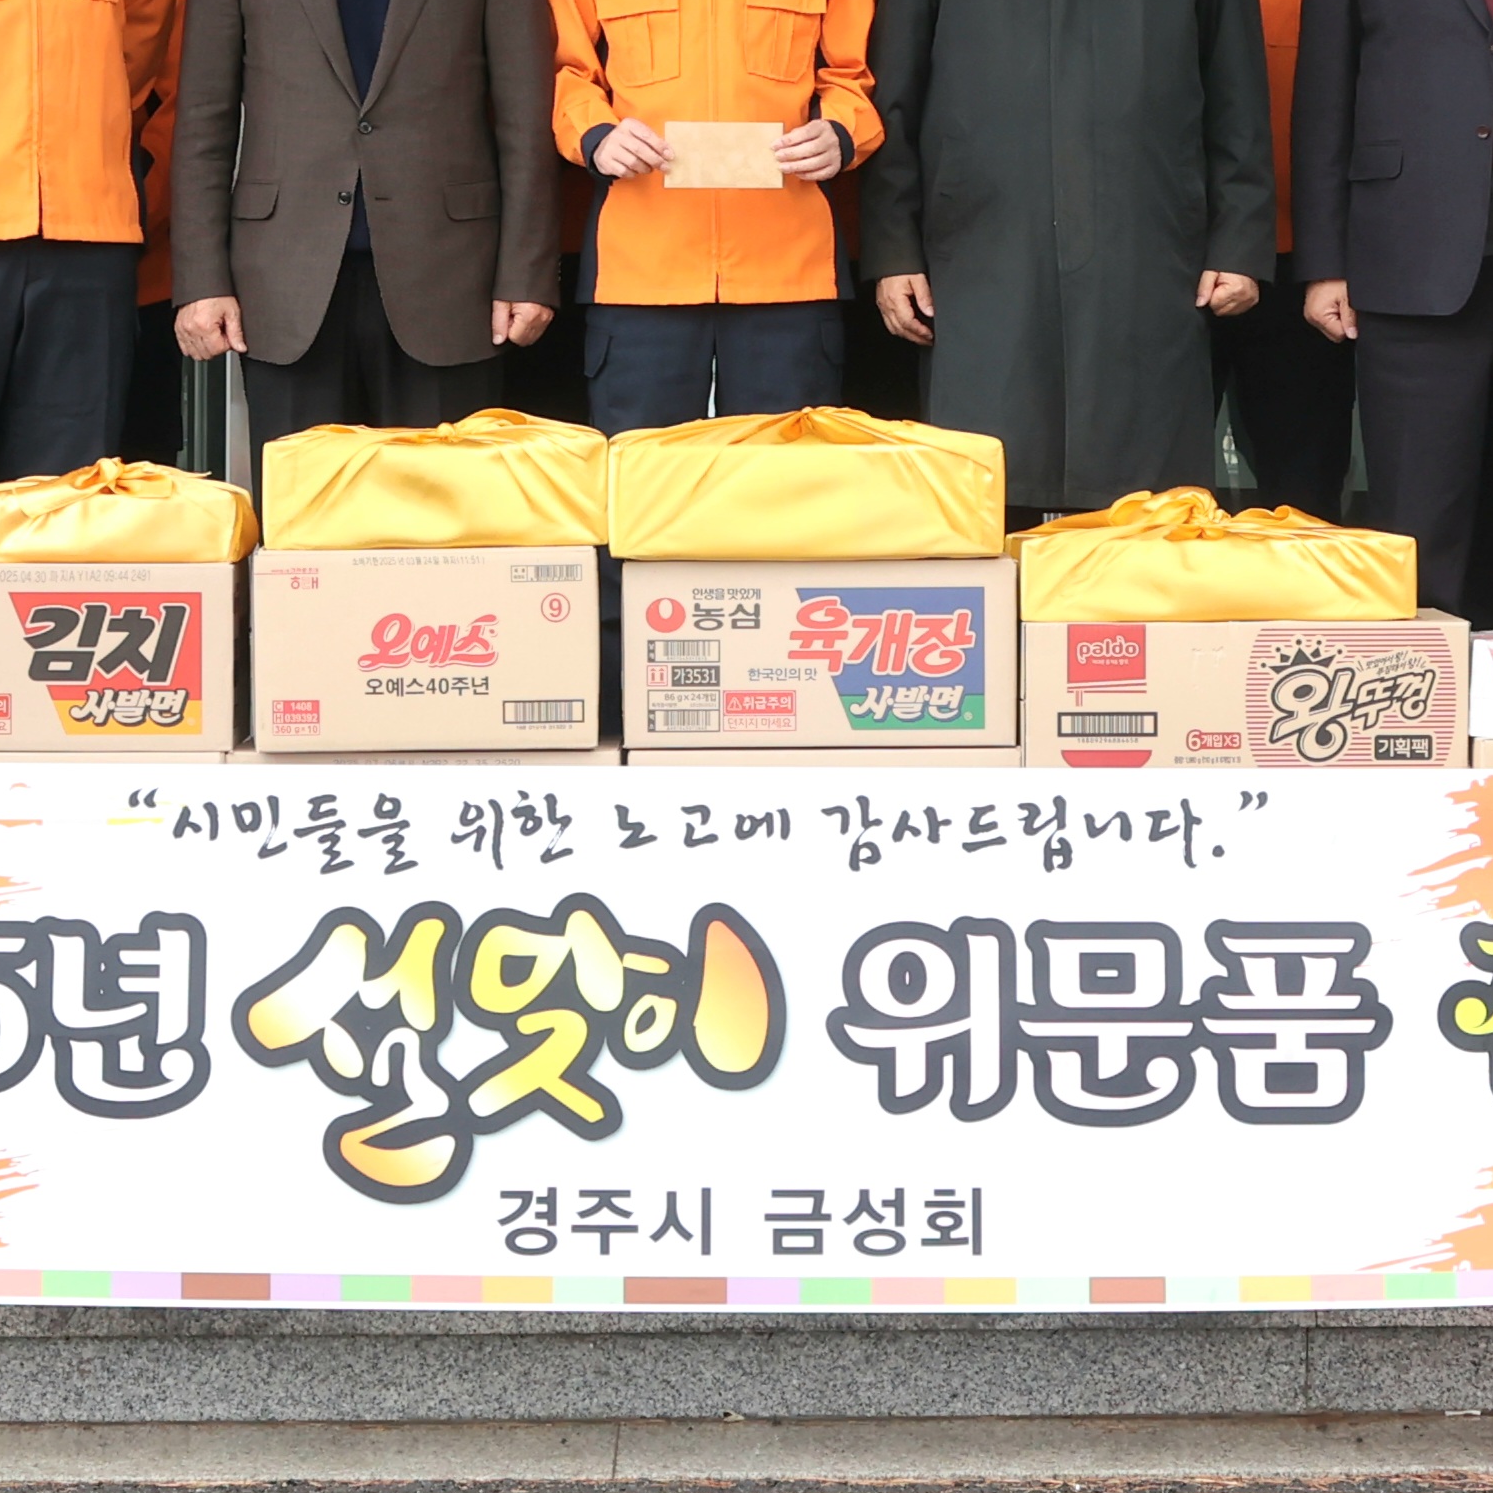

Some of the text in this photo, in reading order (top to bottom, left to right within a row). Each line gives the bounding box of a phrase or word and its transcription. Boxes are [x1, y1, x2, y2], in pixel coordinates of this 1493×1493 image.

[692, 588, 762, 600] 인생을 맛있게
[692, 603, 761, 631] 농심
[24, 603, 187, 687] 김치
[357, 612, 500, 672] 오예스
[788, 596, 976, 677] 육개장
[1076, 635, 1140, 665] paldo
[364, 675, 490, 697] 오예스40주년
[673, 667, 718, 684] 가3531
[747, 667, 818, 681] 한국인의 맛
[69, 689, 187, 728] 사발면
[743, 695, 792, 710] 취급주의
[849, 685, 964, 723] 사발면
[1268, 667, 1437, 763] 왕뚜껑
[727, 717, 793, 729] 던지지 마세요
[1378, 738, 1429, 758] 기획팩
[450, 789, 573, 870] 위한
[618, 801, 791, 850] 노고에
[231, 893, 788, 1205] 설맞이
[826, 916, 1394, 1128] 위문품
[496, 1186, 984, 1255] 경주시 금성회
